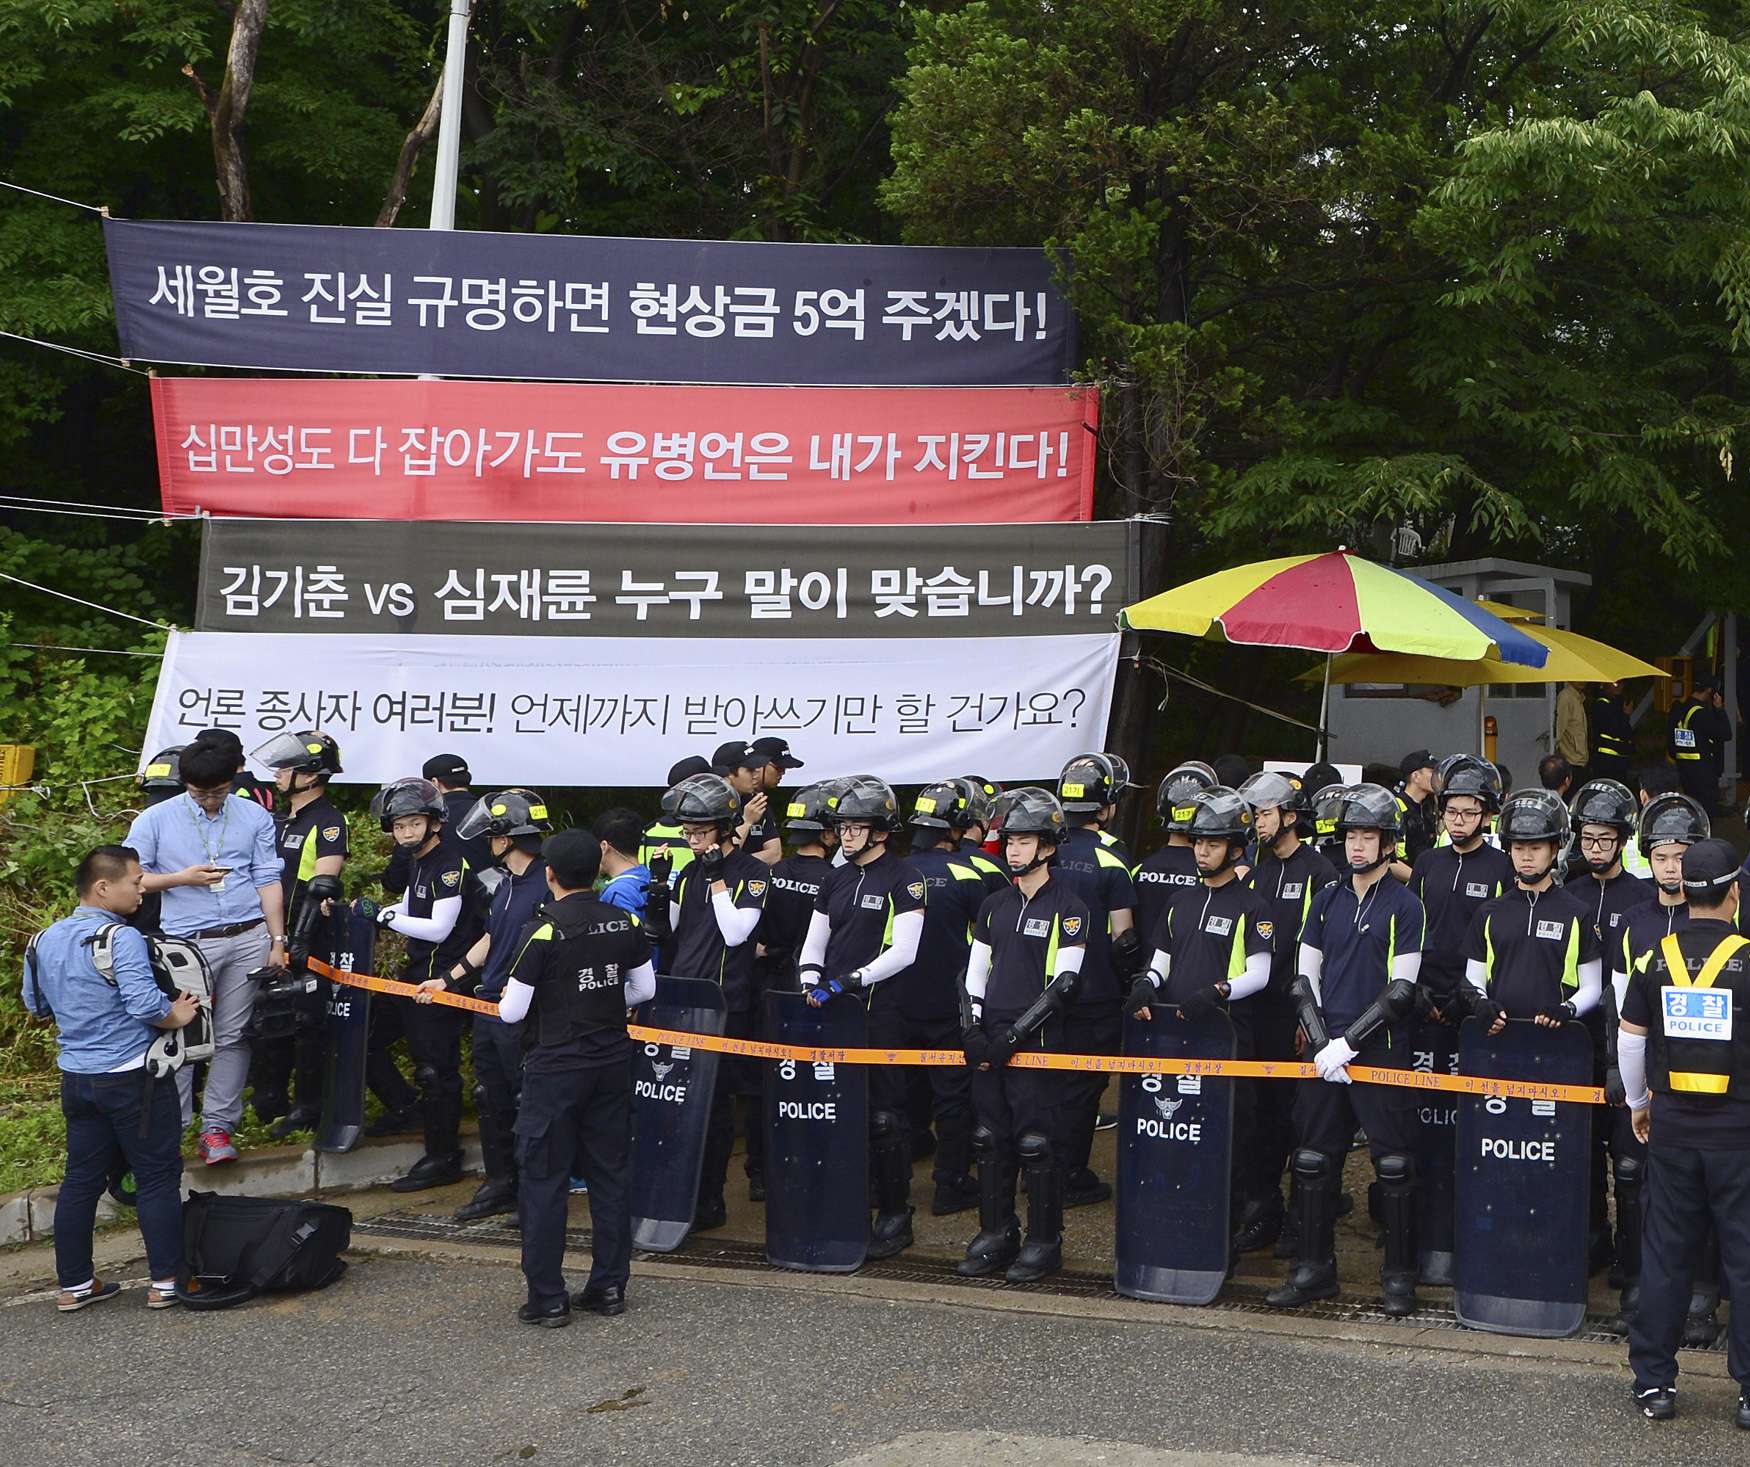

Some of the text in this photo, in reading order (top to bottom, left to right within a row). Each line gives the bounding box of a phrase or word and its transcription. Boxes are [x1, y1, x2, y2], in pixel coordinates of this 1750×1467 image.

[150, 265, 1048, 342] 세월호 진실 규명하면 현상금 5억 주겠다!
[181, 423, 1068, 481] 십만성도 다 잡아가도 유병언은 내가 지킨다!
[219, 564, 1112, 621] 김기춘 vs 심재륜 누구 말이 맞습니까?
[178, 686, 1086, 736] 언론 종사자 여러분! 언제까지 받아쓰기만 할 건가요?
[1060, 860, 1095, 874] LICE
[771, 876, 819, 895] POLICE
[1138, 872, 1198, 886] POLICE
[578, 963, 619, 983] 경찰
[579, 978, 619, 991] POLICE
[1669, 993, 1724, 1018] 경찰
[1670, 1021, 1723, 1032] POLICE
[1025, 1056, 1048, 1067] LINE
[1371, 1070, 1441, 1088] POLICE LINE
[635, 1080, 686, 1102] POLICE
[1466, 1080, 1567, 1099] 이 선을 넘지마시오!
[779, 1101, 836, 1120] POLICE
[1137, 1118, 1202, 1141] POLICE
[1481, 1138, 1555, 1161] POLICE
